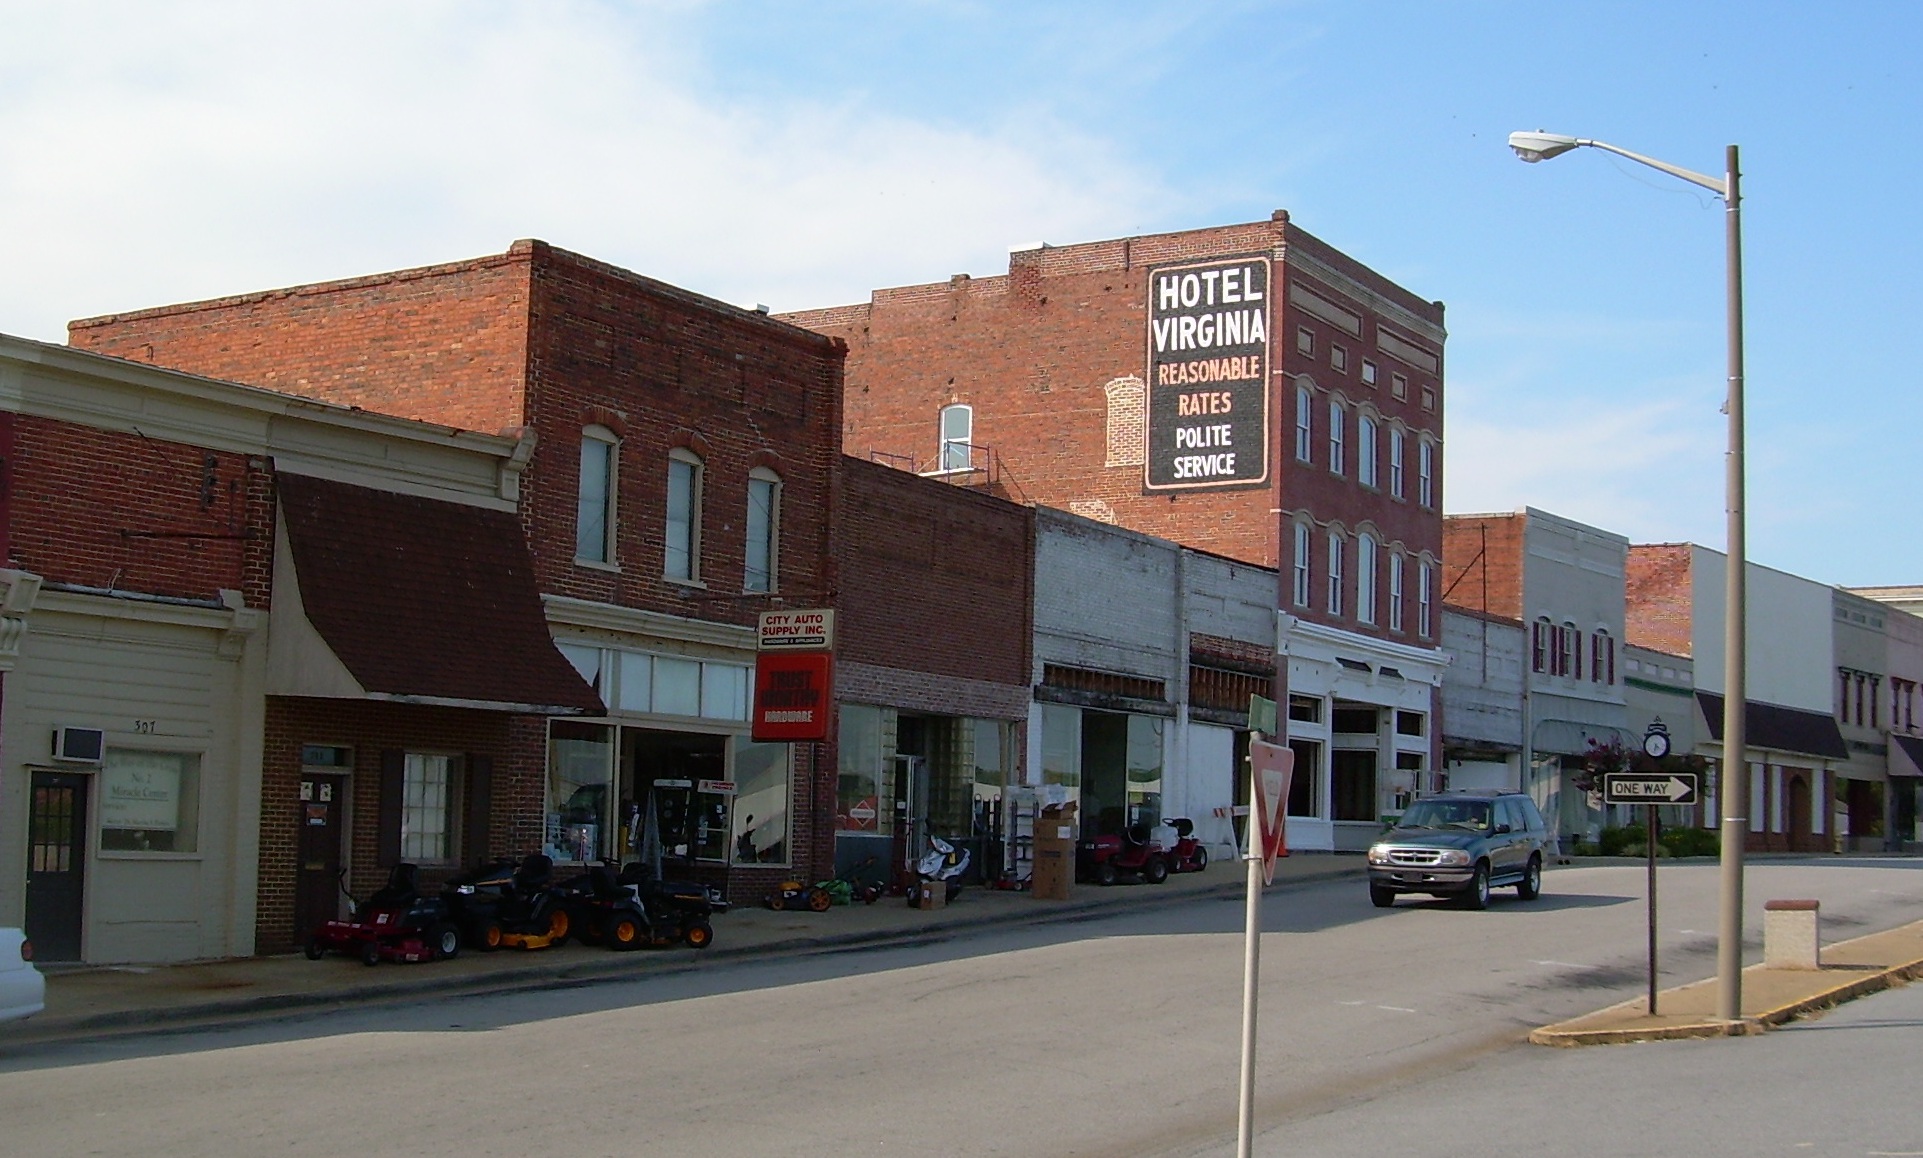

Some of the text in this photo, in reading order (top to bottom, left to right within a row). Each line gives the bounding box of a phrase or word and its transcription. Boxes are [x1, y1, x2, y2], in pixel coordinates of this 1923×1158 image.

[1159, 267, 1263, 310] HOTEL
[1153, 308, 1266, 352] VIRGINIA
[1158, 355, 1260, 386] REASONABLE
[1178, 392, 1232, 416] RATES
[1176, 424, 1232, 448] POLITE
[1173, 453, 1236, 479] SERVICE
[761, 625, 827, 636] SUPPLY INC.
[765, 614, 824, 625] CITY AUTO
[764, 710, 813, 723] HARDWARE
[1615, 783, 1669, 794] ONE WAY
